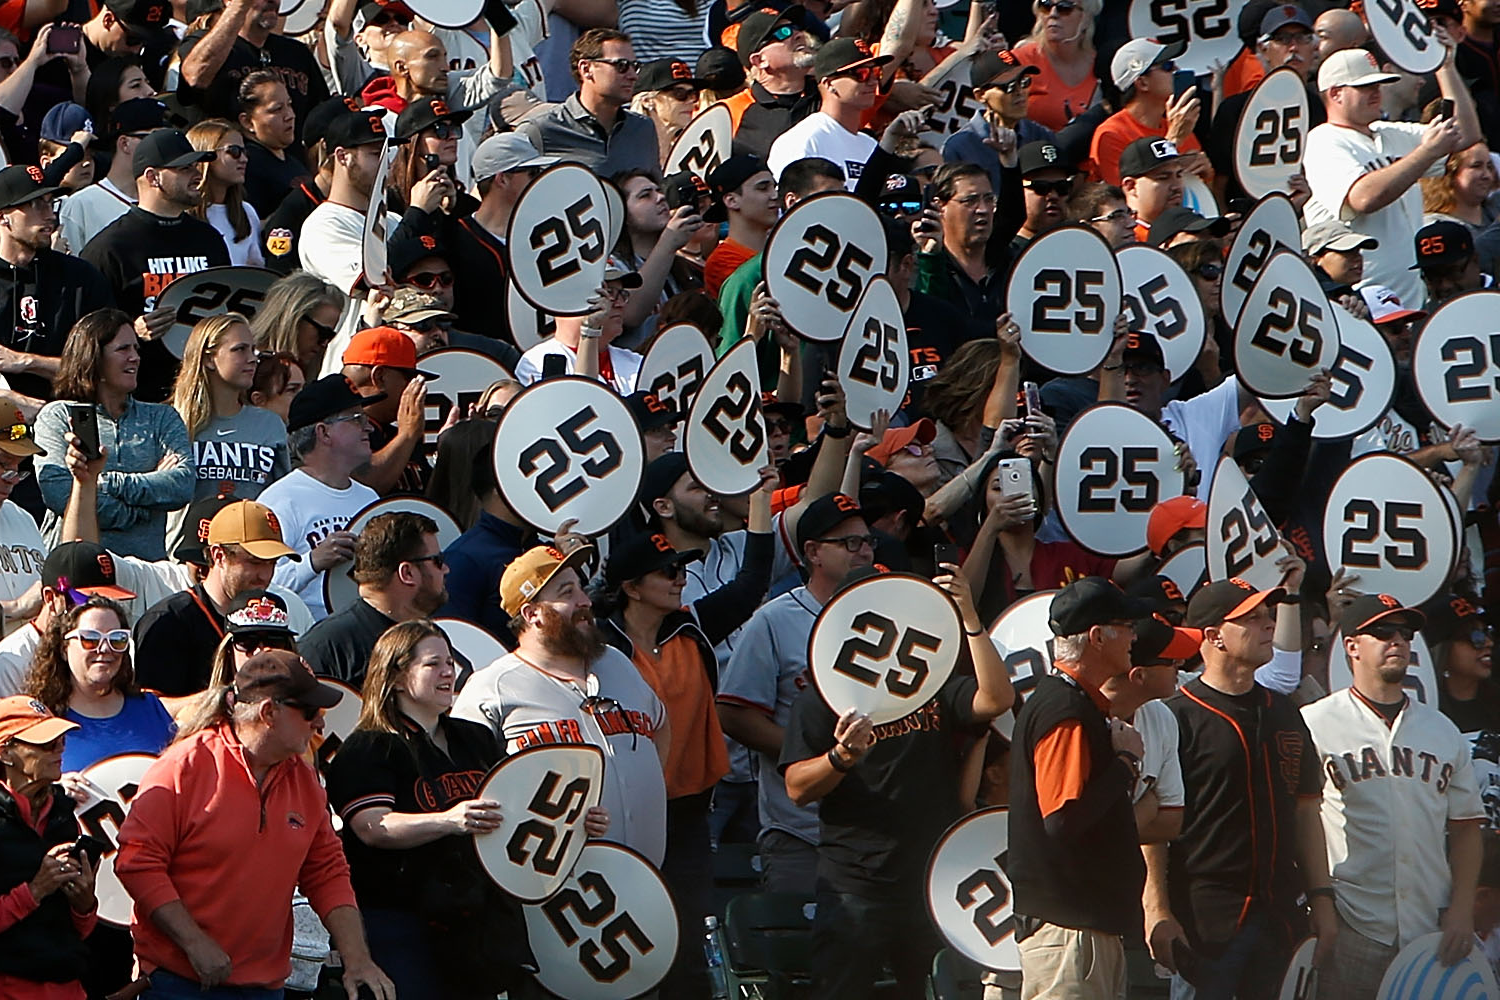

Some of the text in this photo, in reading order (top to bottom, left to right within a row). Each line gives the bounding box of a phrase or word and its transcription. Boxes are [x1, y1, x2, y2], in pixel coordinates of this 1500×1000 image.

[1251, 106, 1301, 167] 25
[147, 256, 209, 274] HIT LIKE
[270, 240, 287, 252] AZ
[530, 194, 604, 285] 25
[784, 224, 872, 312] 25
[1420, 235, 1446, 255] 25
[1031, 269, 1104, 333] 25
[1252, 286, 1323, 366] 25
[849, 317, 899, 391] 25
[703, 371, 766, 465] 25
[1256, 423, 1276, 442] SF
[193, 442, 275, 475] IANTS
[195, 464, 250, 481] ASEBALL
[517, 405, 623, 512] 25
[1077, 446, 1160, 513] 25
[1221, 487, 1281, 578] 25
[1341, 499, 1428, 569] 25
[833, 611, 941, 698] 25
[555, 709, 654, 744] FRANCISC
[1324, 744, 1456, 795] GIANTS
[507, 771, 591, 876] 25
[542, 870, 655, 986] 25
